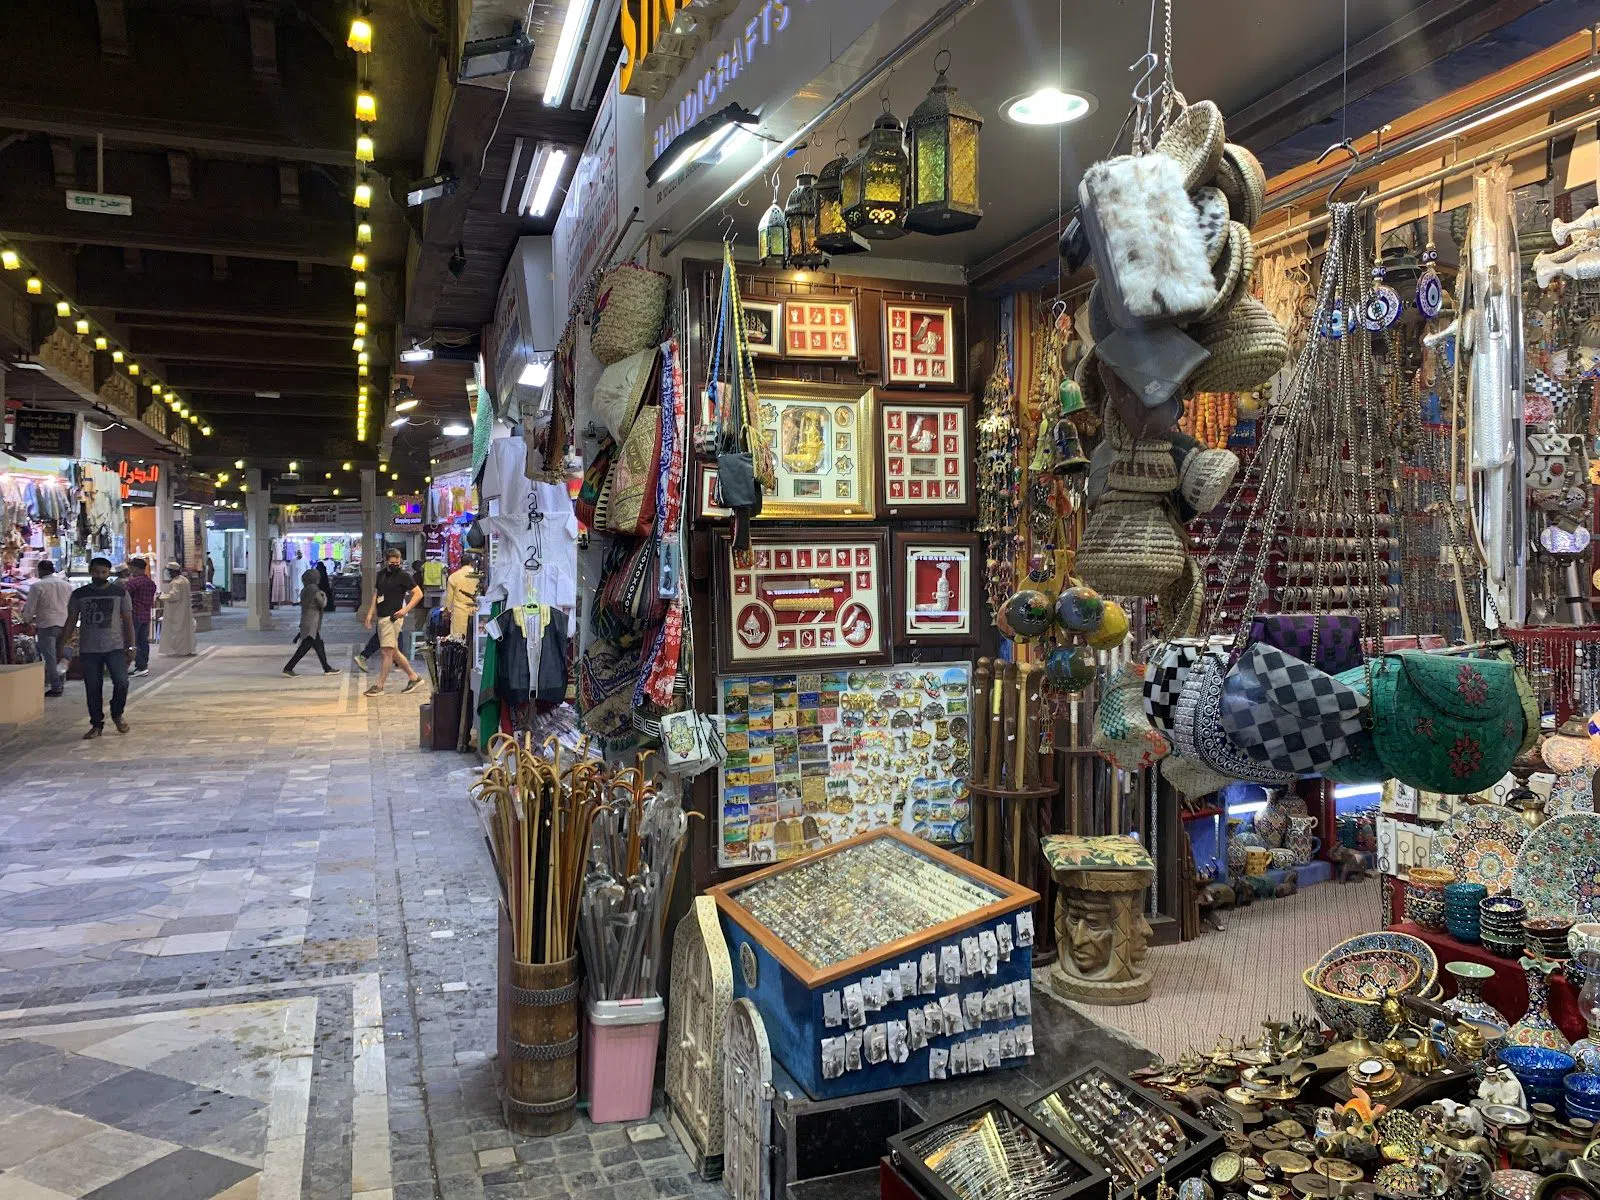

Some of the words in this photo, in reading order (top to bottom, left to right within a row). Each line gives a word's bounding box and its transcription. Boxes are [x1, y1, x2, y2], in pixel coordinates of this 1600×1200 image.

[653, 0, 792, 158] HANDICRAFTS
[75, 196, 96, 205] EXIT
[827, 780, 848, 788] OMAN
